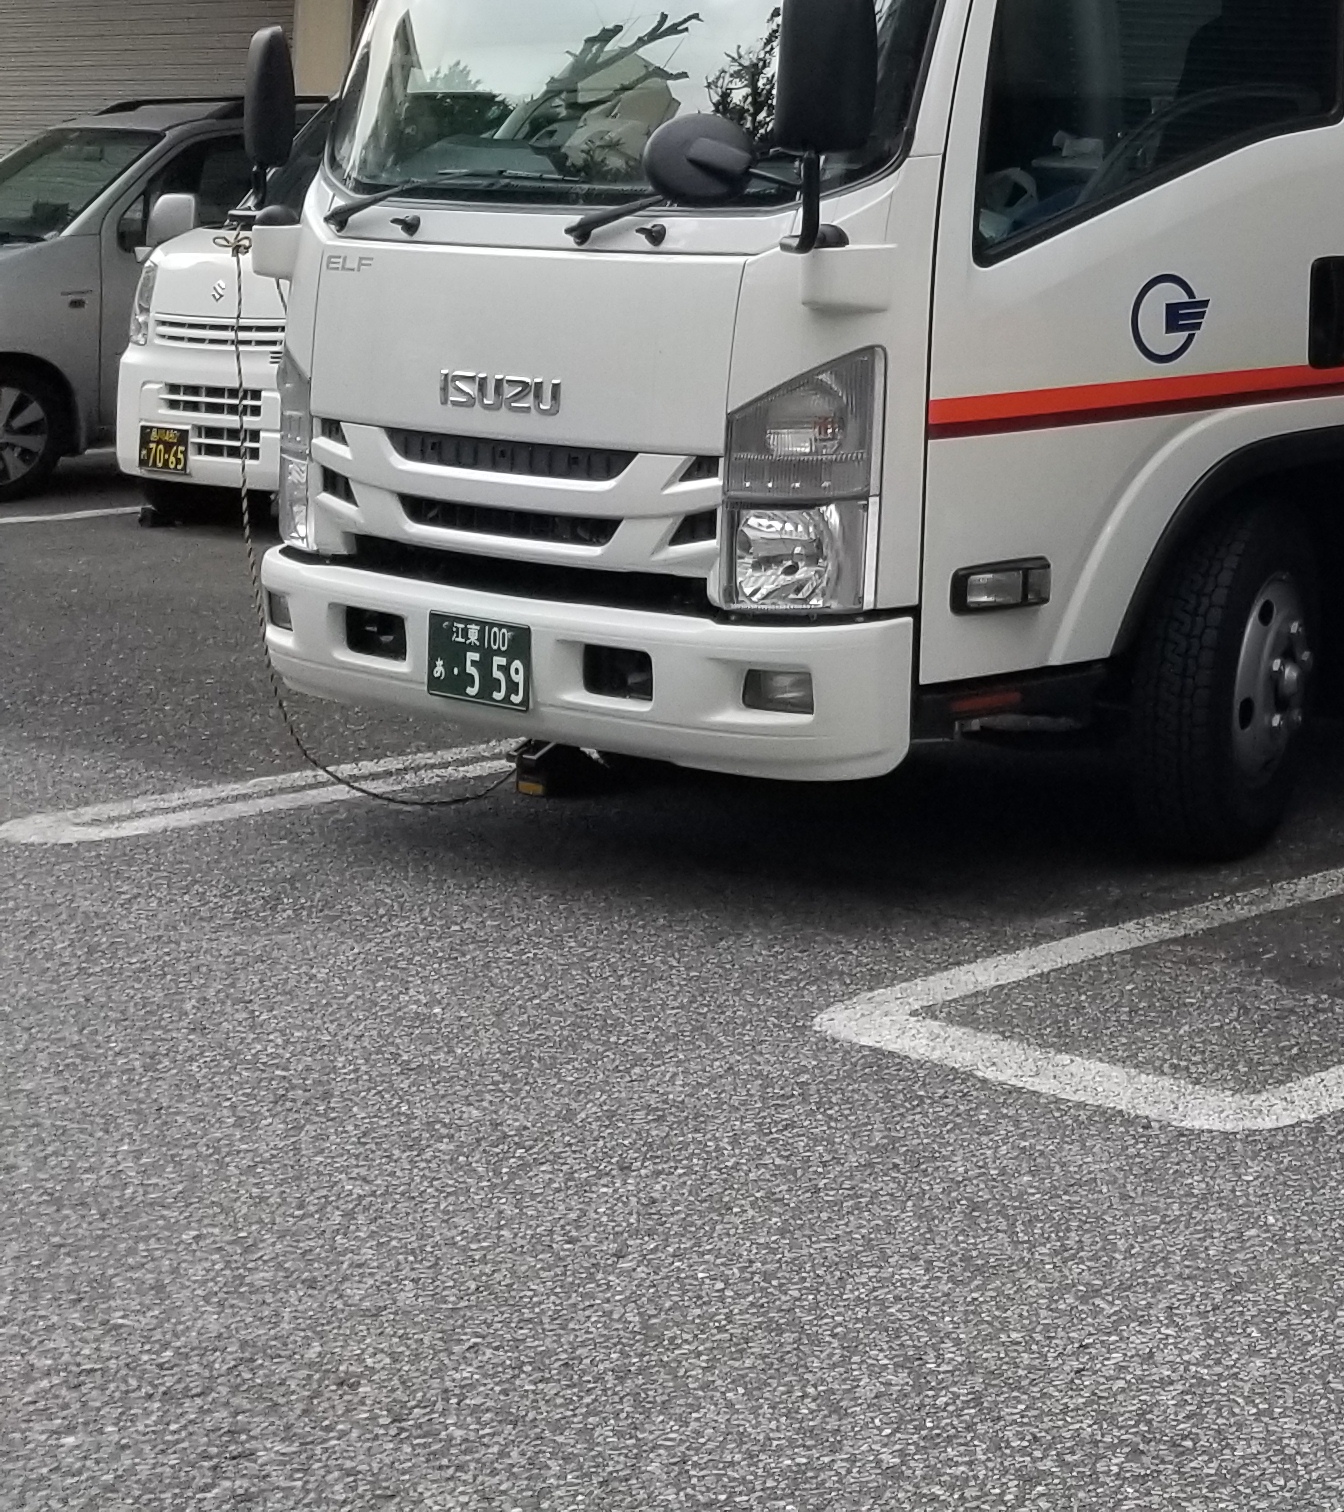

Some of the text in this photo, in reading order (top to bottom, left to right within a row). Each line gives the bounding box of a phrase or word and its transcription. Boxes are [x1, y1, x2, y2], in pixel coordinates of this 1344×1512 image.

[325, 255, 374, 272] ELF
[439, 368, 561, 416] ISUZU
[452, 621, 508, 651] 江東 100
[433, 657, 445, 680] あ
